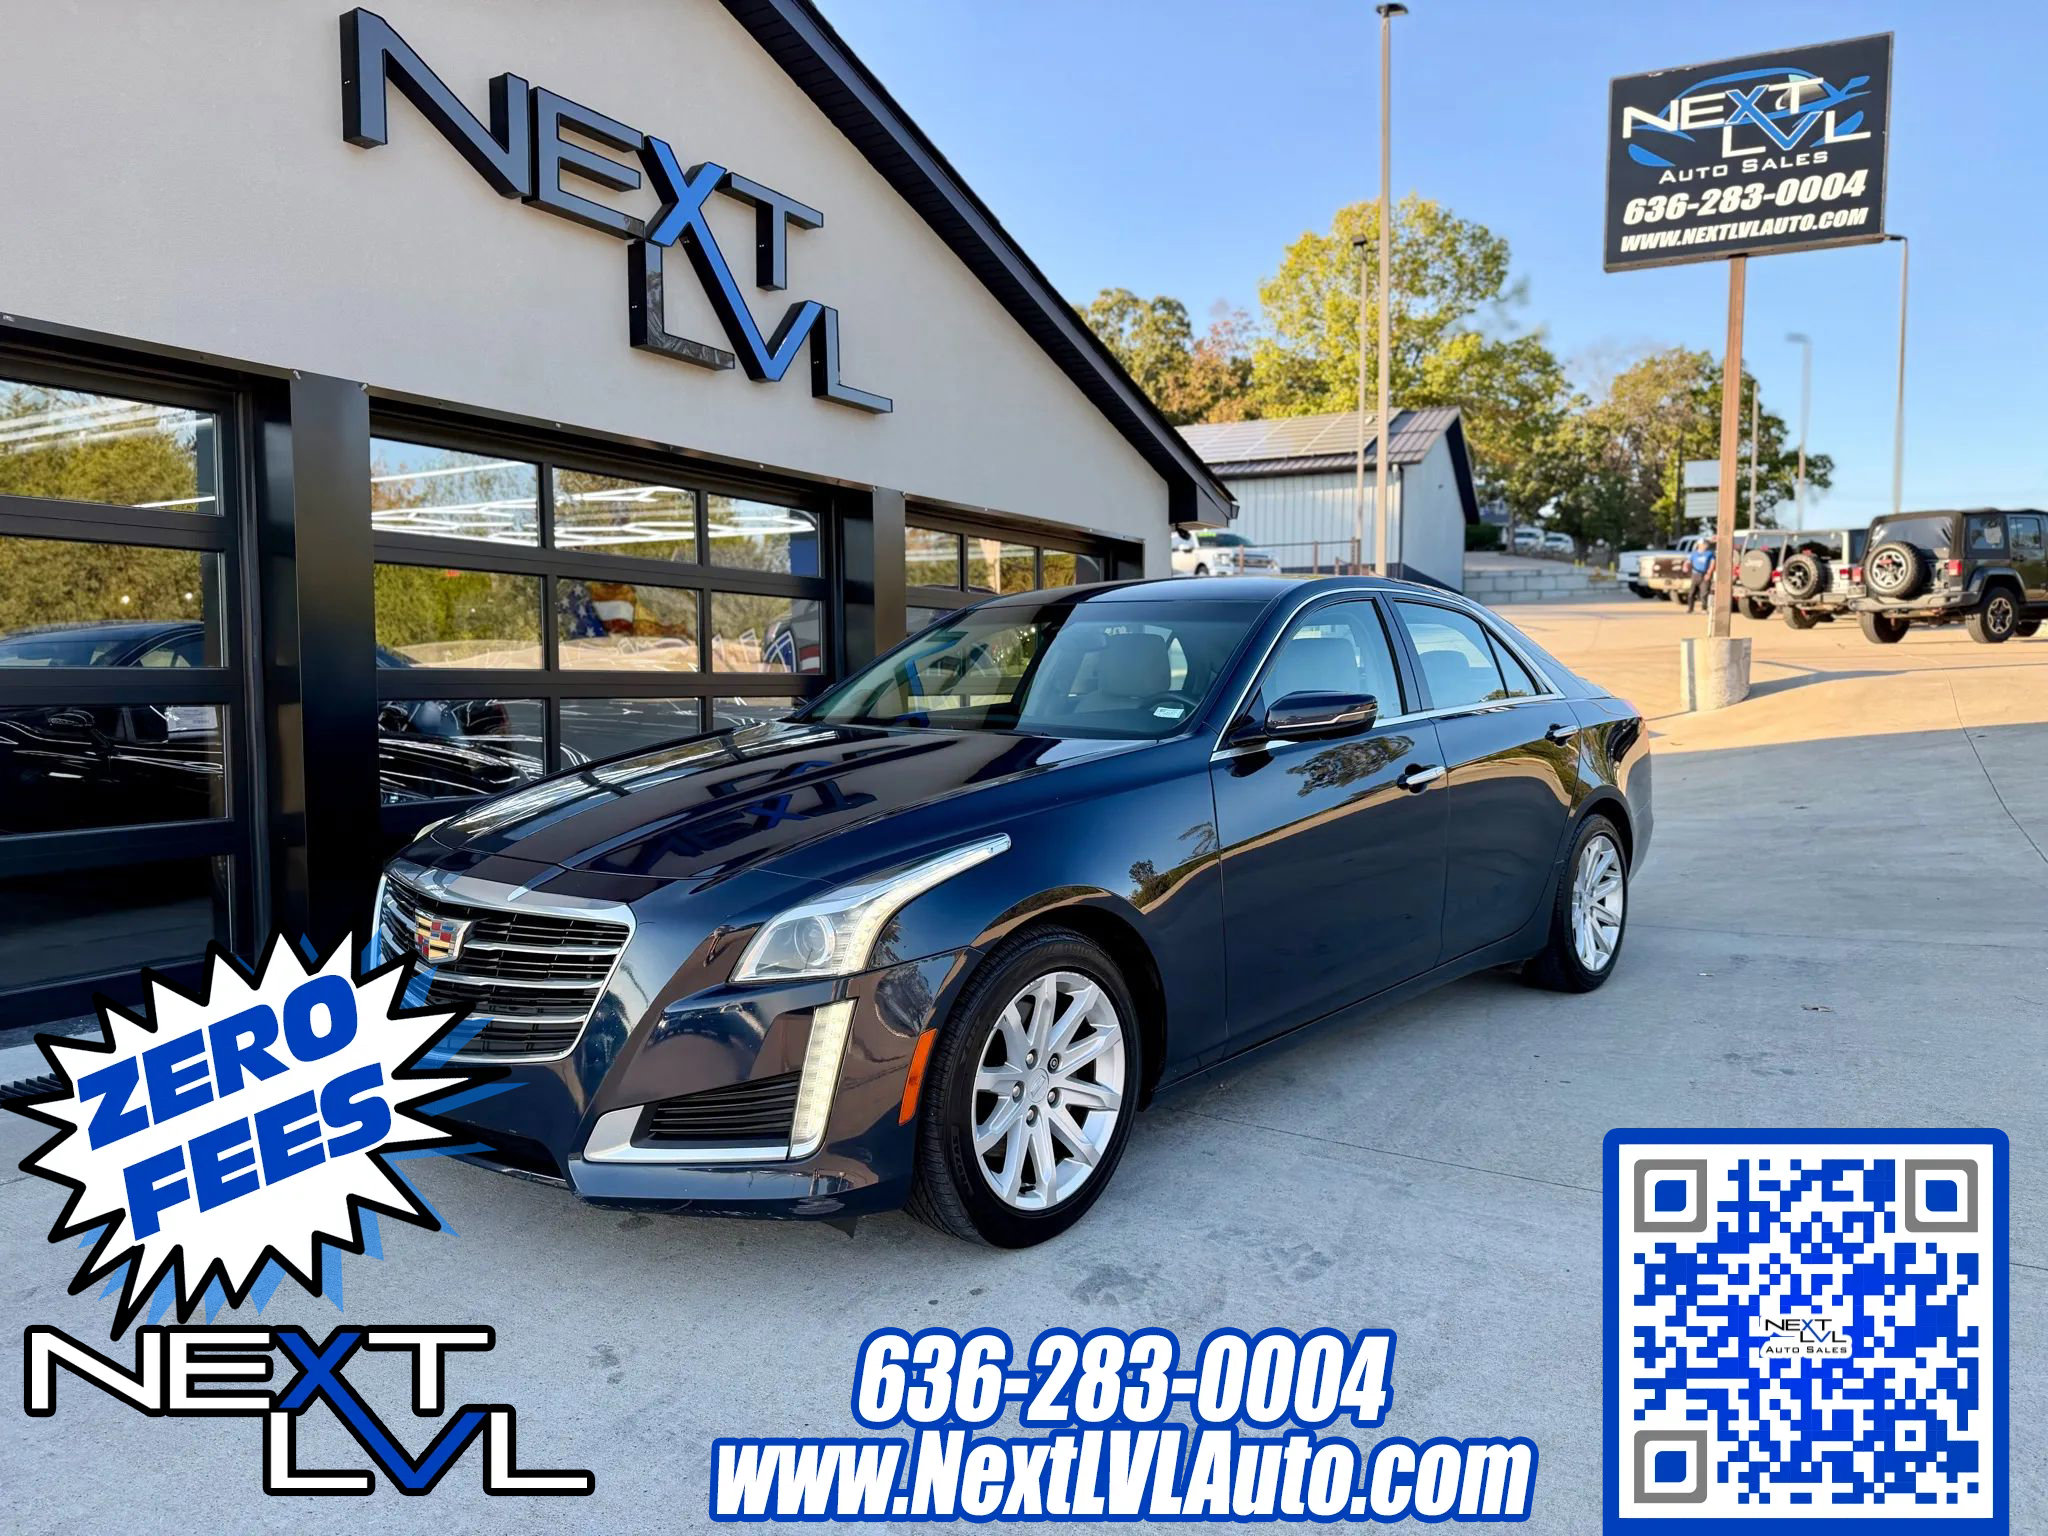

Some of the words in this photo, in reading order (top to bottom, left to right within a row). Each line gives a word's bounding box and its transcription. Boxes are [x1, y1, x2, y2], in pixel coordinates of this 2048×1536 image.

[1622, 77, 1824, 139] NEXT
[1722, 110, 1871, 158] LVL
[340, 7, 824, 291] NEXT
[1658, 164, 1728, 184] AUTO
[1742, 151, 1828, 173] SALES
[1622, 169, 1869, 226] 636-283-0004
[1620, 207, 1869, 253] WWW.NEXTLVLAUTO.COM
[628, 239, 893, 414] LVL
